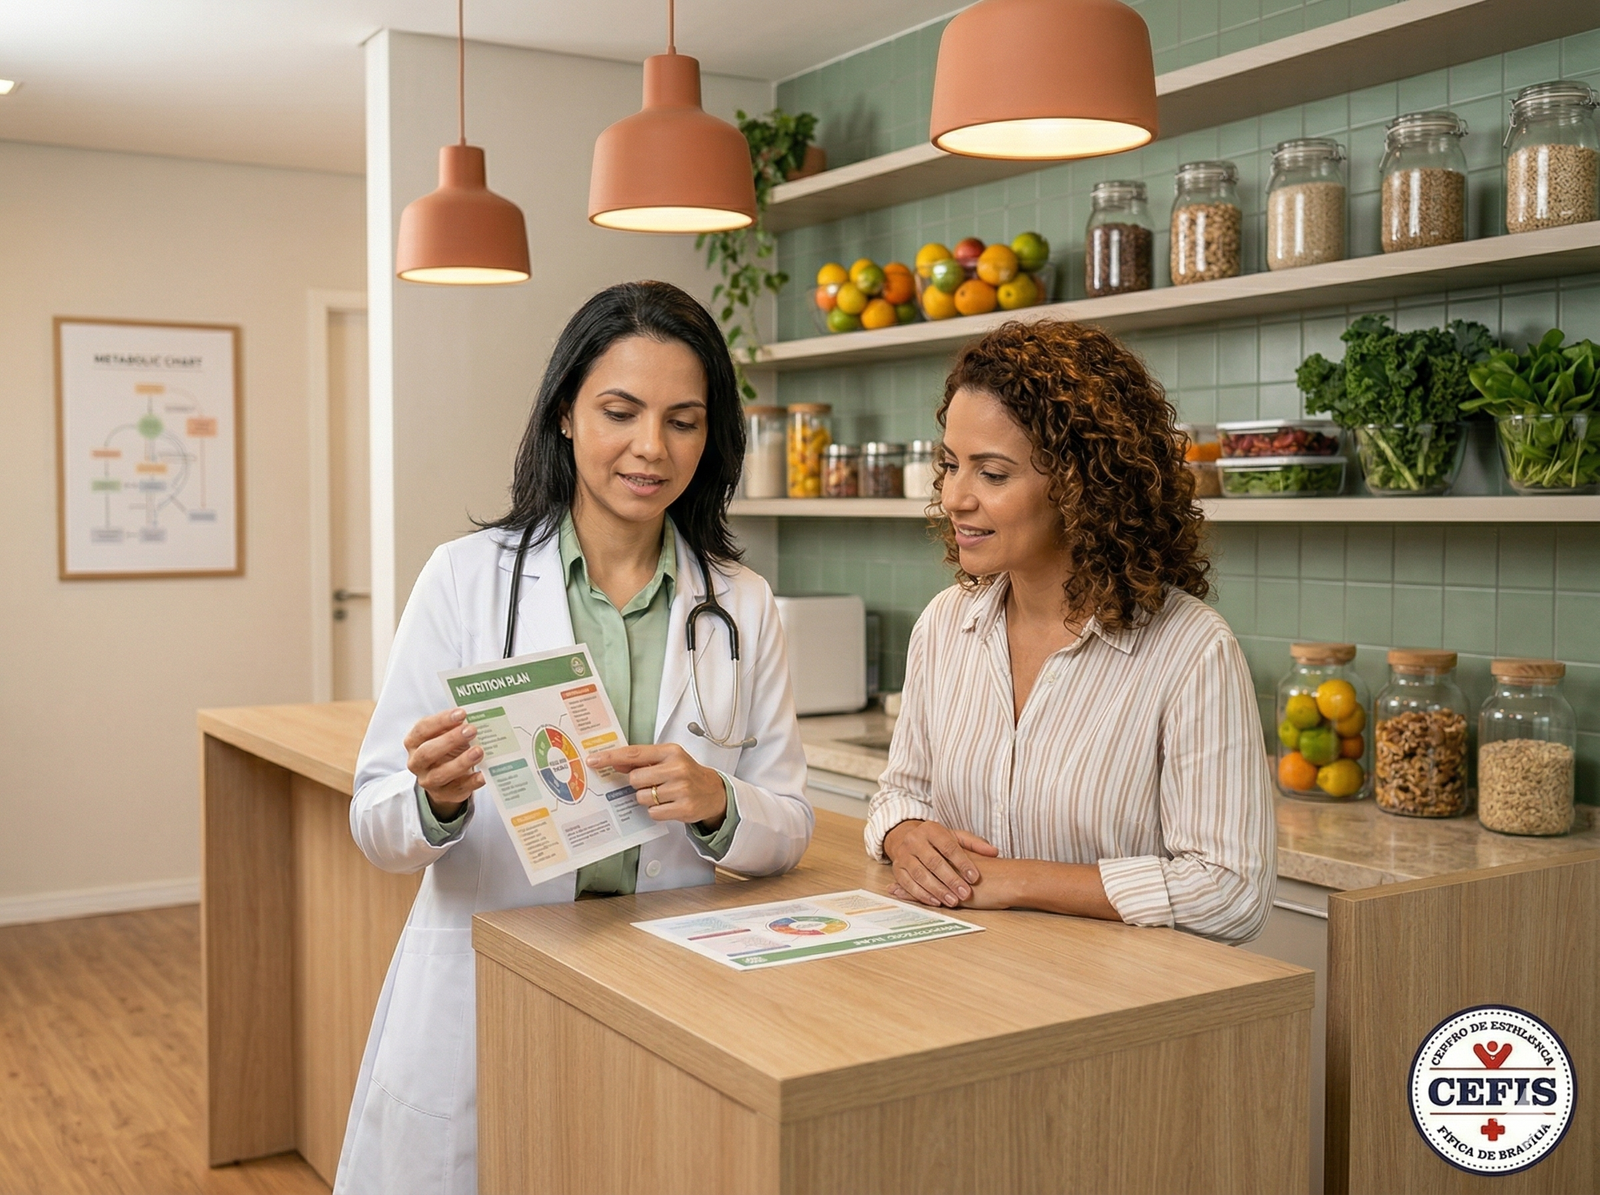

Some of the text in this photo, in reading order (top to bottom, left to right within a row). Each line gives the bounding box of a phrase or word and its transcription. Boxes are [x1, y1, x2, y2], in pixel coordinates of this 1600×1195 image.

[94, 354, 202, 368] METABOLIC CHART
[455, 672, 531, 697] NUTRITION PLAN
